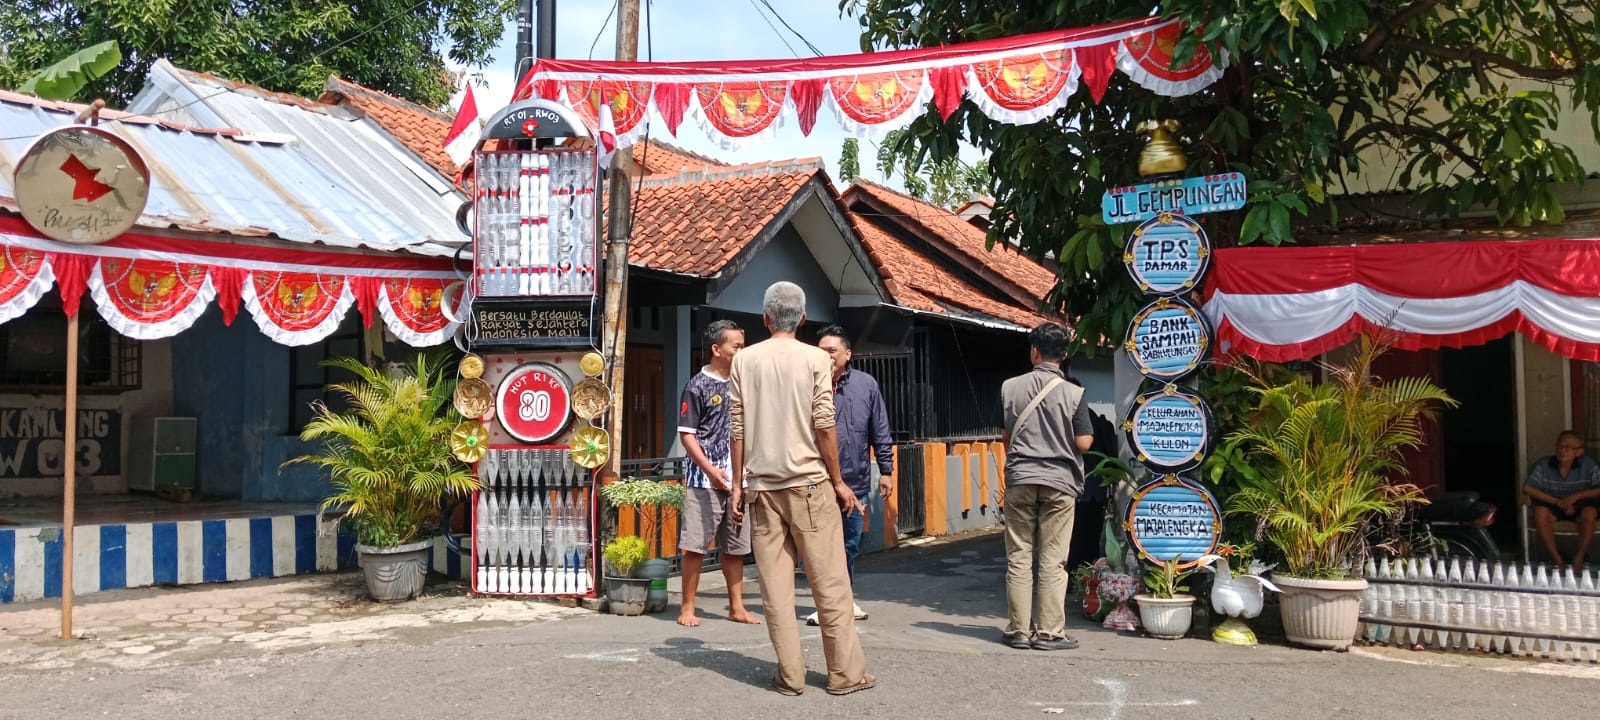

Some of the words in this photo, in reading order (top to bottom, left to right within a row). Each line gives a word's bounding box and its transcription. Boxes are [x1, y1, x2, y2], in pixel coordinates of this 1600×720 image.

[504, 113, 516, 126] RT
[1138, 180, 1245, 213] GEMPUNGAN
[1142, 239, 1189, 261] TPS
[1145, 261, 1188, 271] DAMAR
[480, 310, 526, 321] Bersatu
[531, 309, 584, 320] Berdaulat
[481, 320, 522, 330] Rakyat
[1150, 317, 1190, 334] BANK
[1141, 331, 1197, 350] SAMPAH
[509, 376, 527, 394] HUT
[519, 389, 551, 422] 80
[1147, 407, 1196, 418] KELURAHAN
[1, 408, 109, 438] KAMLNG
[1139, 420, 1200, 432] MAJALENGKA
[1153, 439, 1189, 449] KULON
[1150, 502, 1207, 515] KECAMATAN
[1136, 518, 1208, 537] MAJALENGKA
